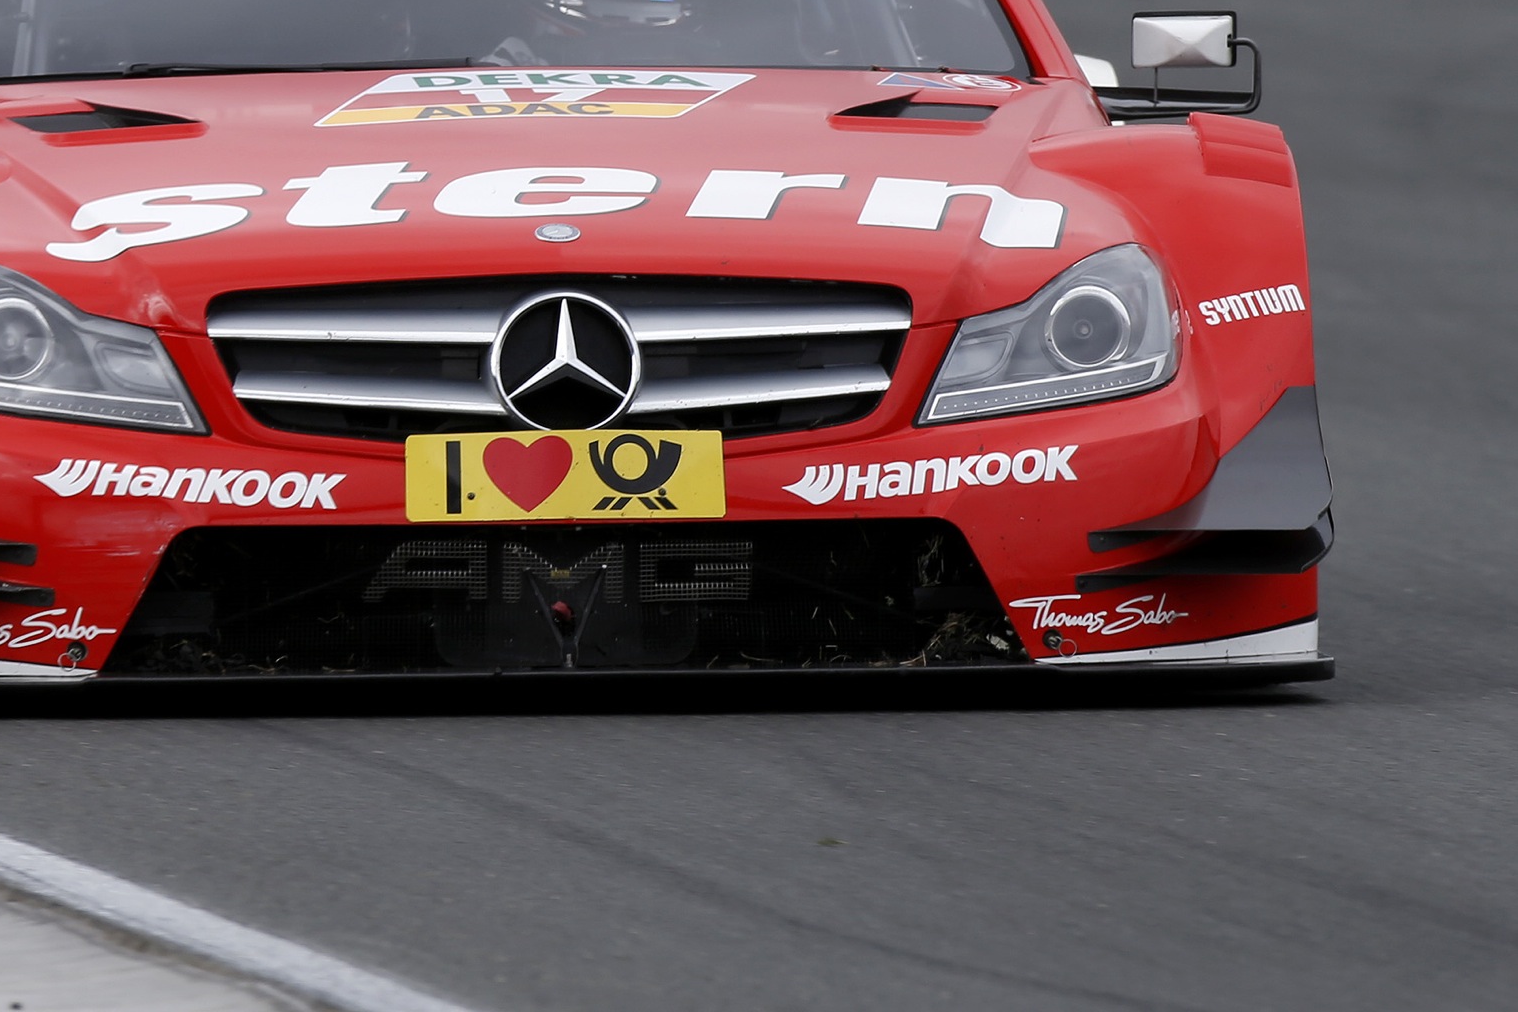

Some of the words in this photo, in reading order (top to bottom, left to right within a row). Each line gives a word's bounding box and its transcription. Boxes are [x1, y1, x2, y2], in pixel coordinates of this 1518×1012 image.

[412, 72, 712, 88] DEKRA
[459, 89, 608, 103] 17
[414, 103, 614, 119] ADAC
[45, 162, 1069, 262] stern
[1198, 283, 1306, 326] SYNTIUM
[445, 440, 462, 515] I
[362, 540, 753, 605] AMG
[8, 606, 117, 648] Sabo
[1008, 593, 1107, 634] Thomas
[1100, 592, 1189, 635] Sabo
